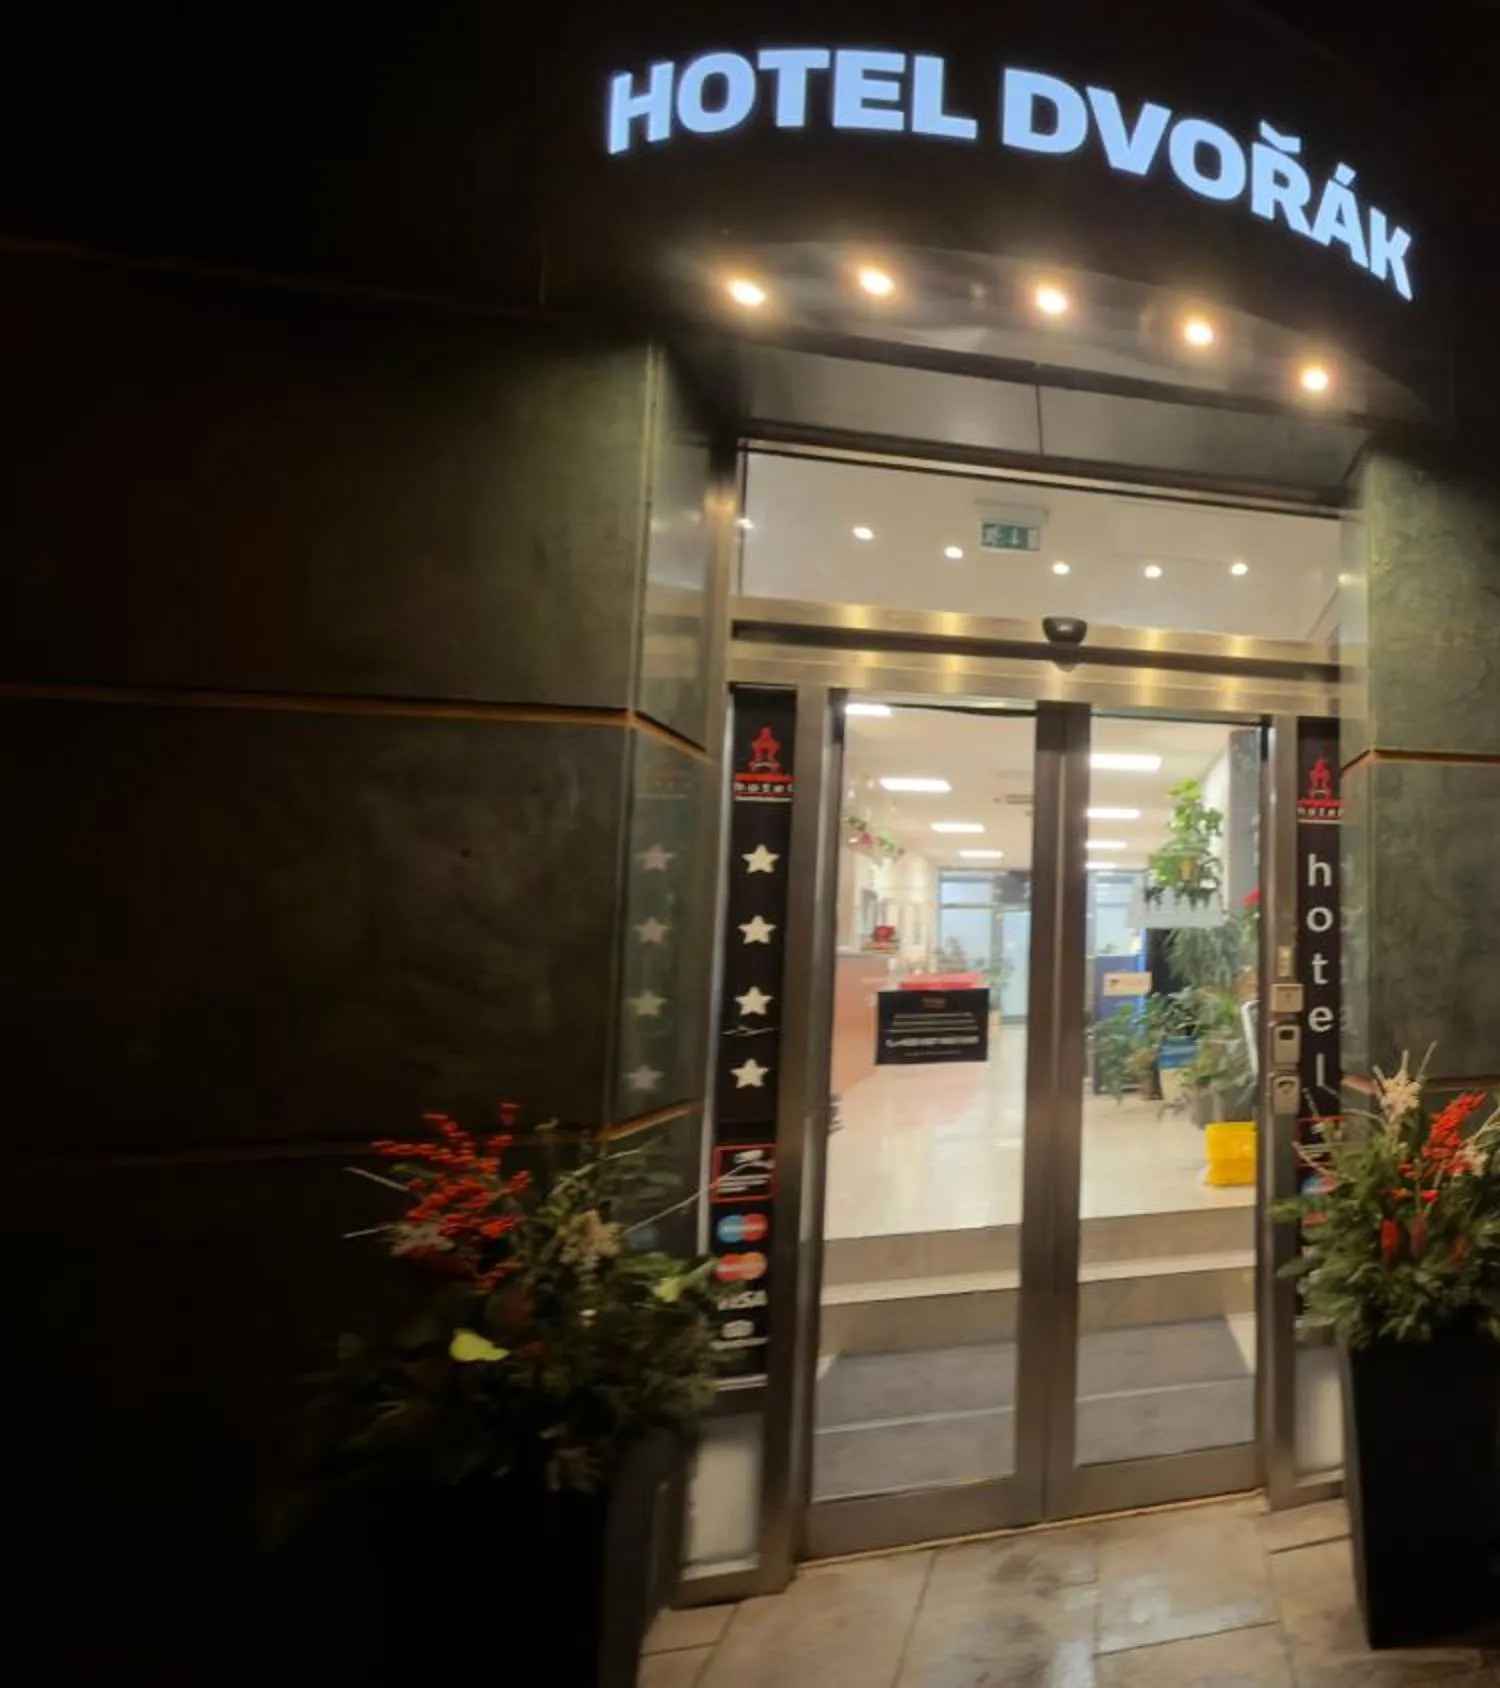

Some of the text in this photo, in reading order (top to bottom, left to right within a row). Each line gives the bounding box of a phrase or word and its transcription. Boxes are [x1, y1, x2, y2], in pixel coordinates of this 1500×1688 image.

[607, 47, 1414, 302] HOTEL DVOŘÁK
[1306, 853, 1334, 1077] hotel
